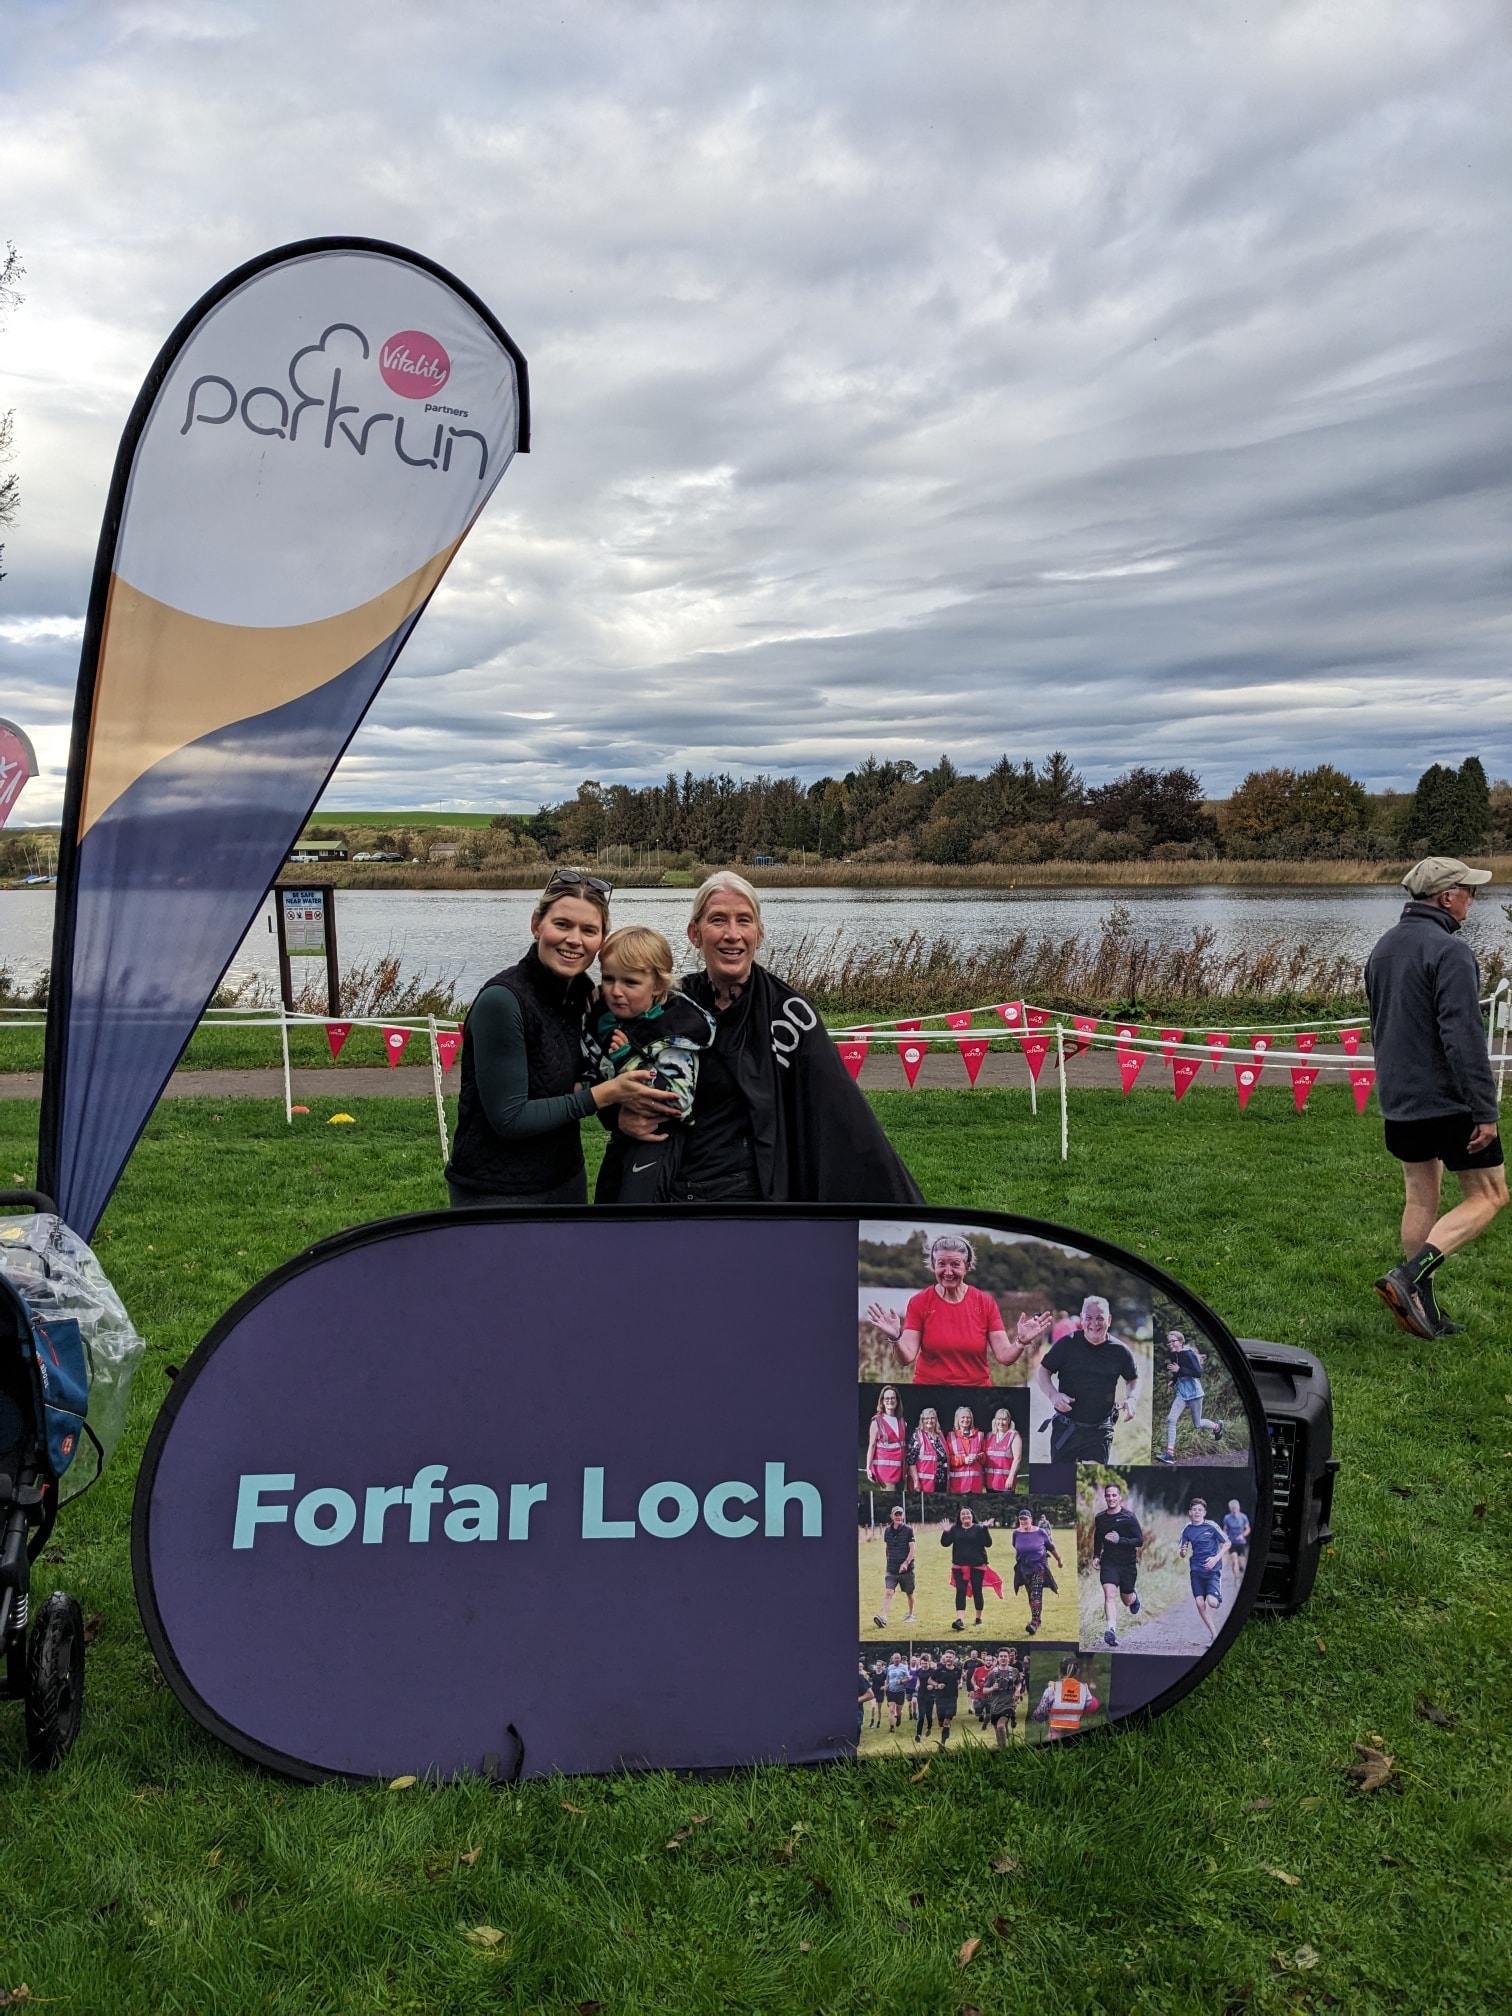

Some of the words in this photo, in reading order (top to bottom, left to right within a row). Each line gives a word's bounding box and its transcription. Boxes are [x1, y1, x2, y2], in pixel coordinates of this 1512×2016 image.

[383, 345, 448, 387] Vitality
[181, 323, 488, 480] parkrun
[424, 403, 469, 418] partners
[233, 1464, 548, 1550] Forfar
[582, 1461, 823, 1540] Loch
